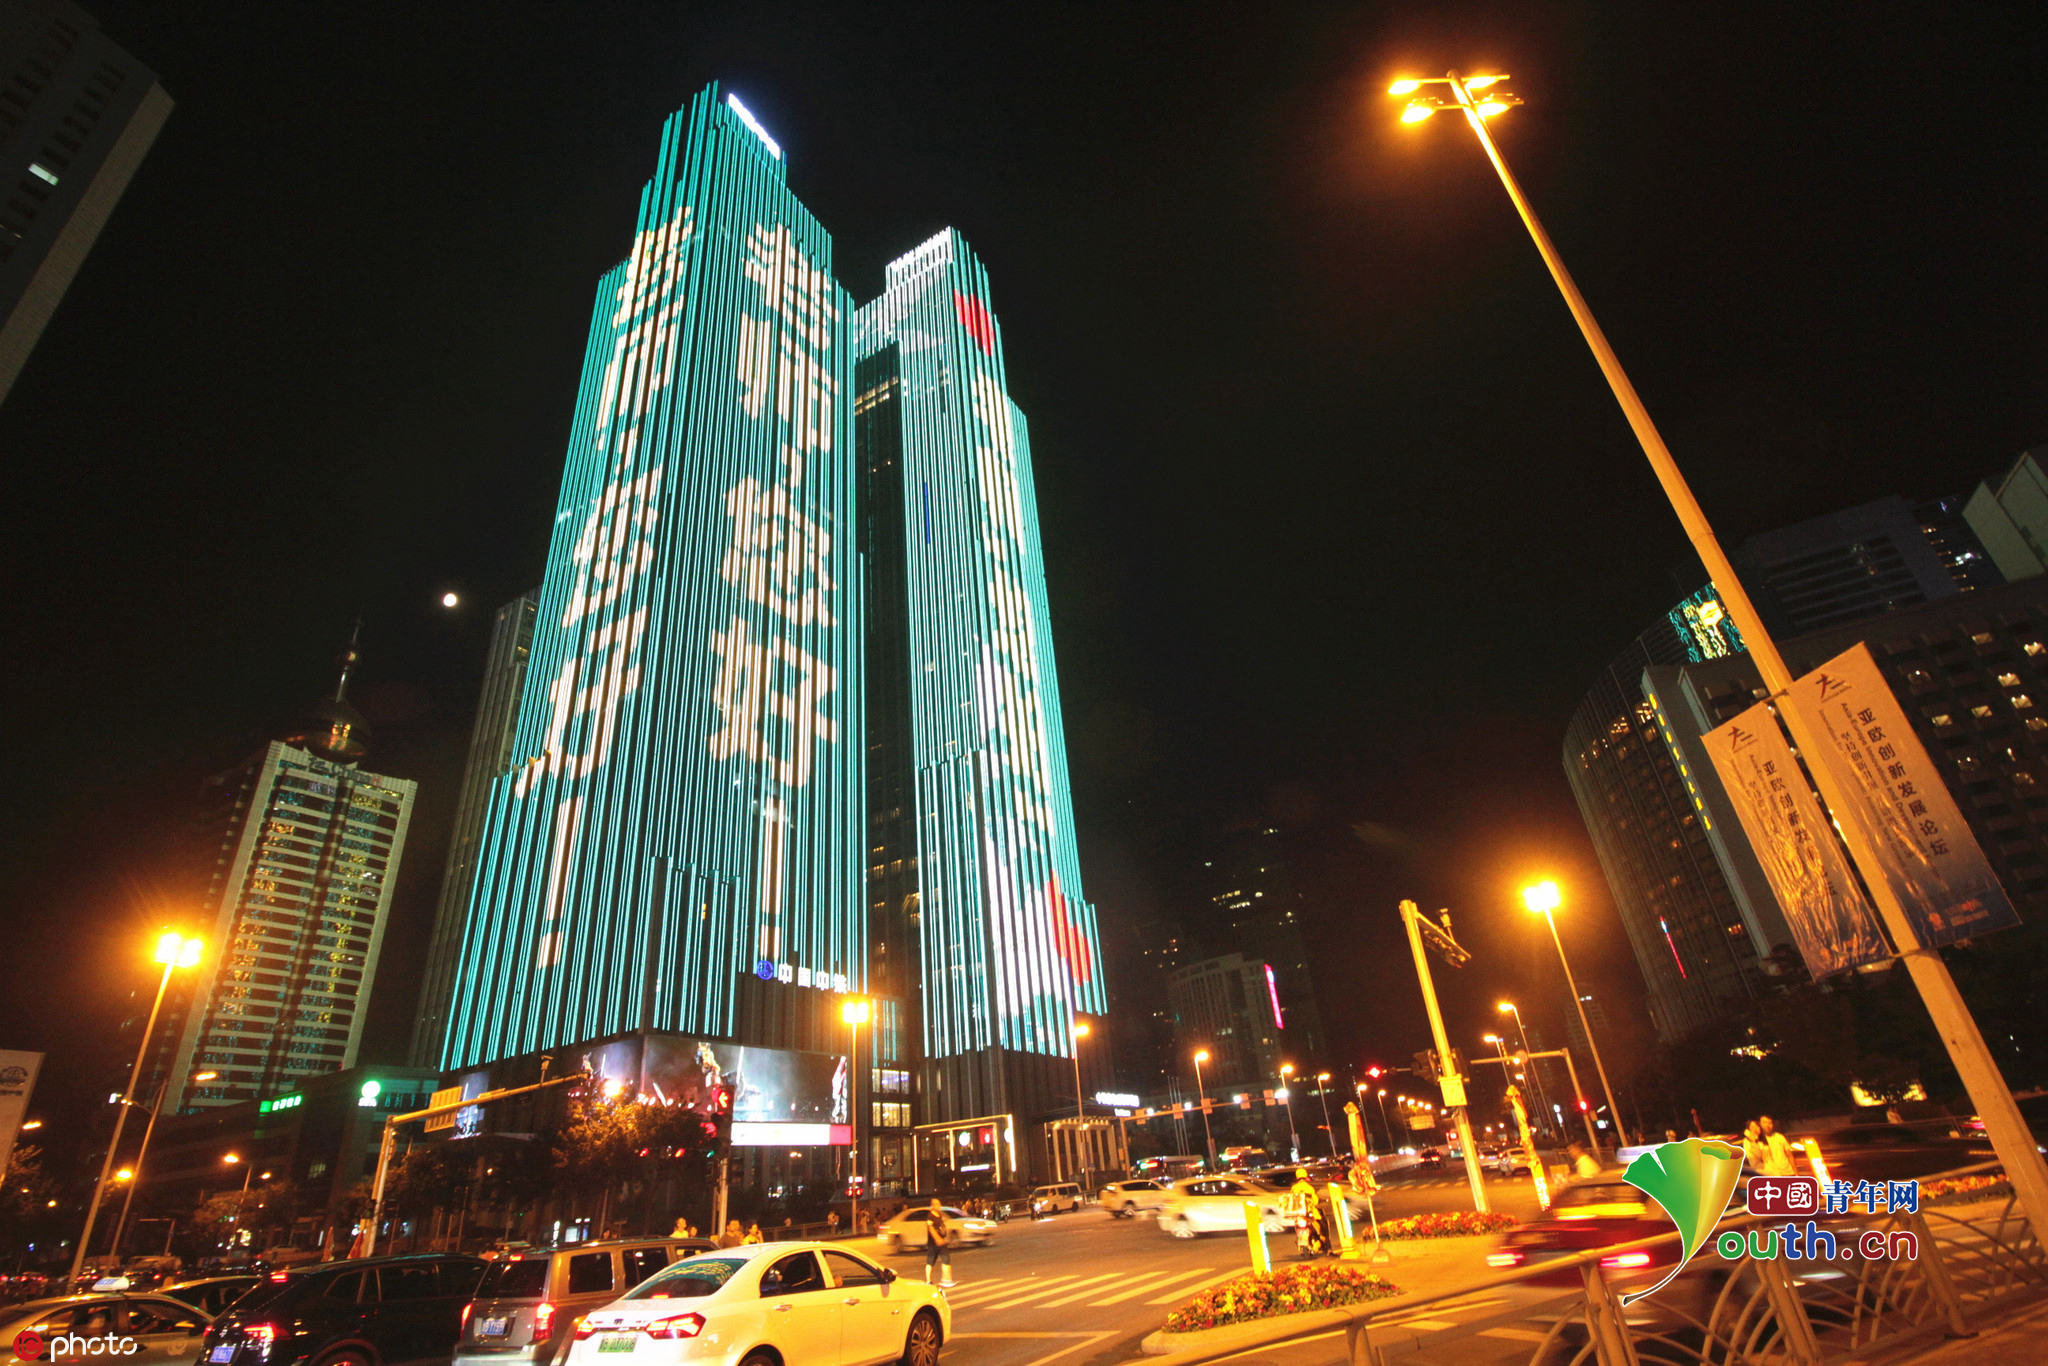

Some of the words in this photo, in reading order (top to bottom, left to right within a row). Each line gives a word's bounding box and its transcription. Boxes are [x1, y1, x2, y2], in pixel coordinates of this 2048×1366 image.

[1858, 706, 1950, 857] 亚欧创新发展论坛
[1886, 786, 1898, 801] and
